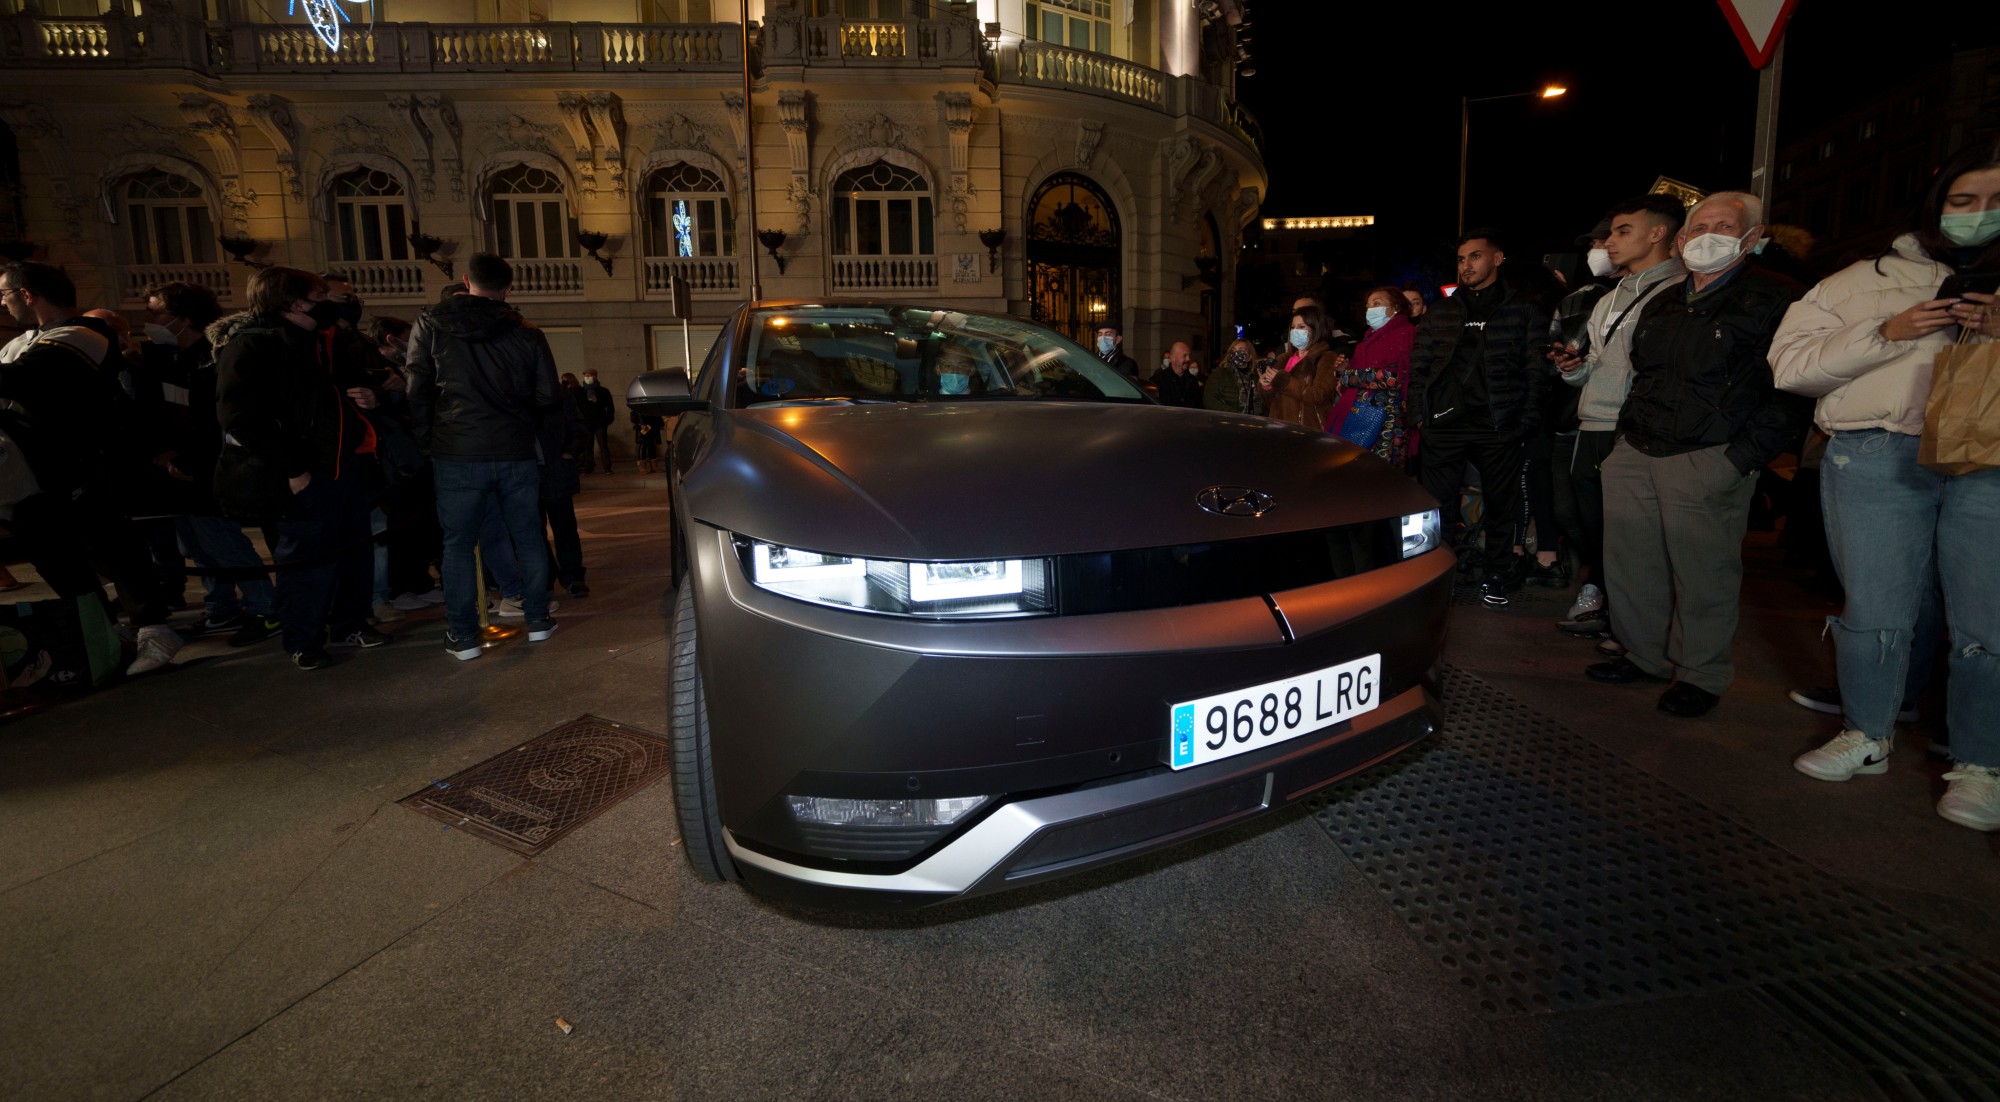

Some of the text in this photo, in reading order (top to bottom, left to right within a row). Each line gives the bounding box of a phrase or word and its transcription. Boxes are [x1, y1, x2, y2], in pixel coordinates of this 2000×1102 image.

[1206, 665, 1372, 750] 9688 LRG
[1179, 741, 1189, 756] E
